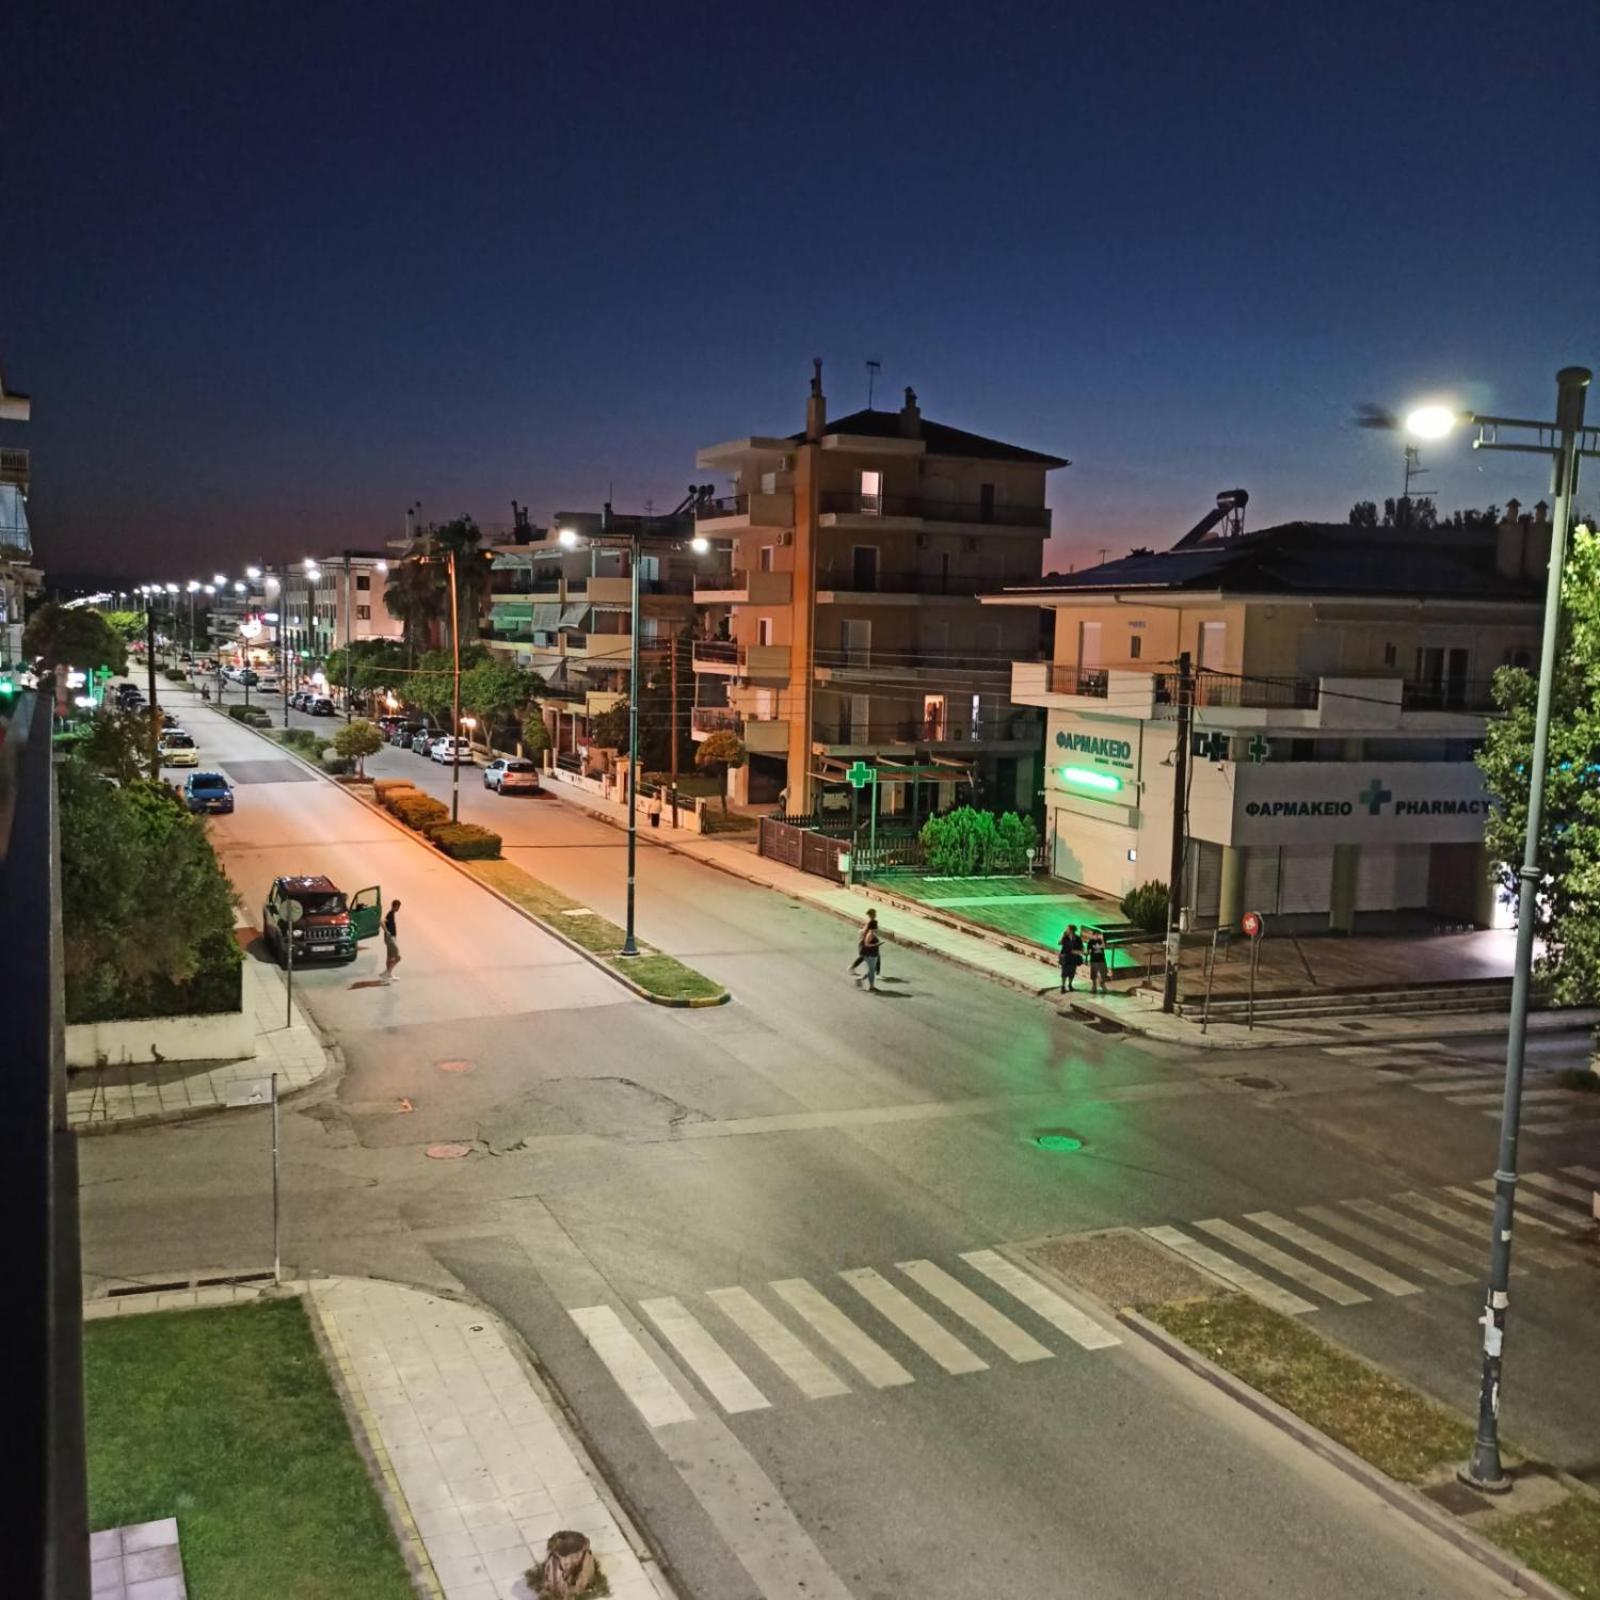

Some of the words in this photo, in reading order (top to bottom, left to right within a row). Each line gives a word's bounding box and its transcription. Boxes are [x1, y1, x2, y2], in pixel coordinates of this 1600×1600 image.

[1056, 731, 1132, 760] ΦΑΡΜΑΚΕΙΟ
[1245, 801, 1352, 816] ΦΑΡΜΑΚΕΙΟ
[1395, 800, 1492, 815] PHARMACY
